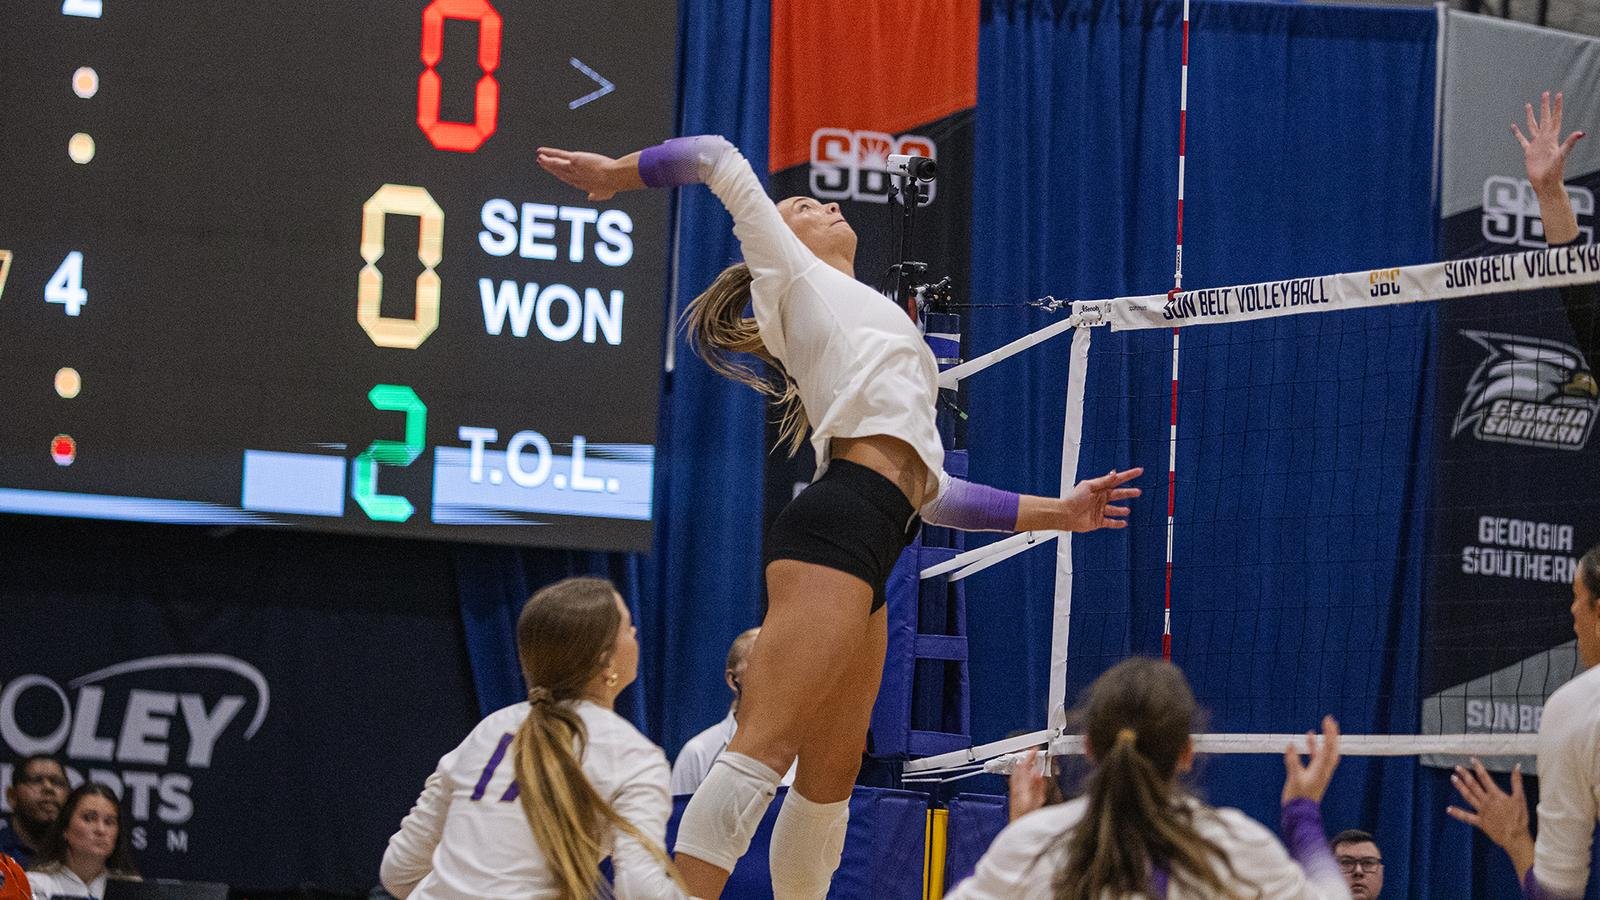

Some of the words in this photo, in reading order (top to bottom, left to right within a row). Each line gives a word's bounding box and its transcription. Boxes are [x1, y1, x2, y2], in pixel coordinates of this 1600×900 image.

[416, 0, 503, 153] 0
[357, 183, 445, 349] 0
[478, 198, 634, 267] SETS
[44, 250, 88, 317] 4
[478, 277, 624, 346] WON
[1163, 295, 1197, 321] SUN
[1199, 288, 1231, 317] BELT
[1235, 276, 1330, 313] VOLLEYBALL
[1483, 416, 1584, 443] SOUTHERN
[1490, 400, 1589, 427] GEORGIA
[353, 383, 427, 522] 2
[458, 425, 621, 493] T.O.L.
[1478, 515, 1574, 552] GEORGIA
